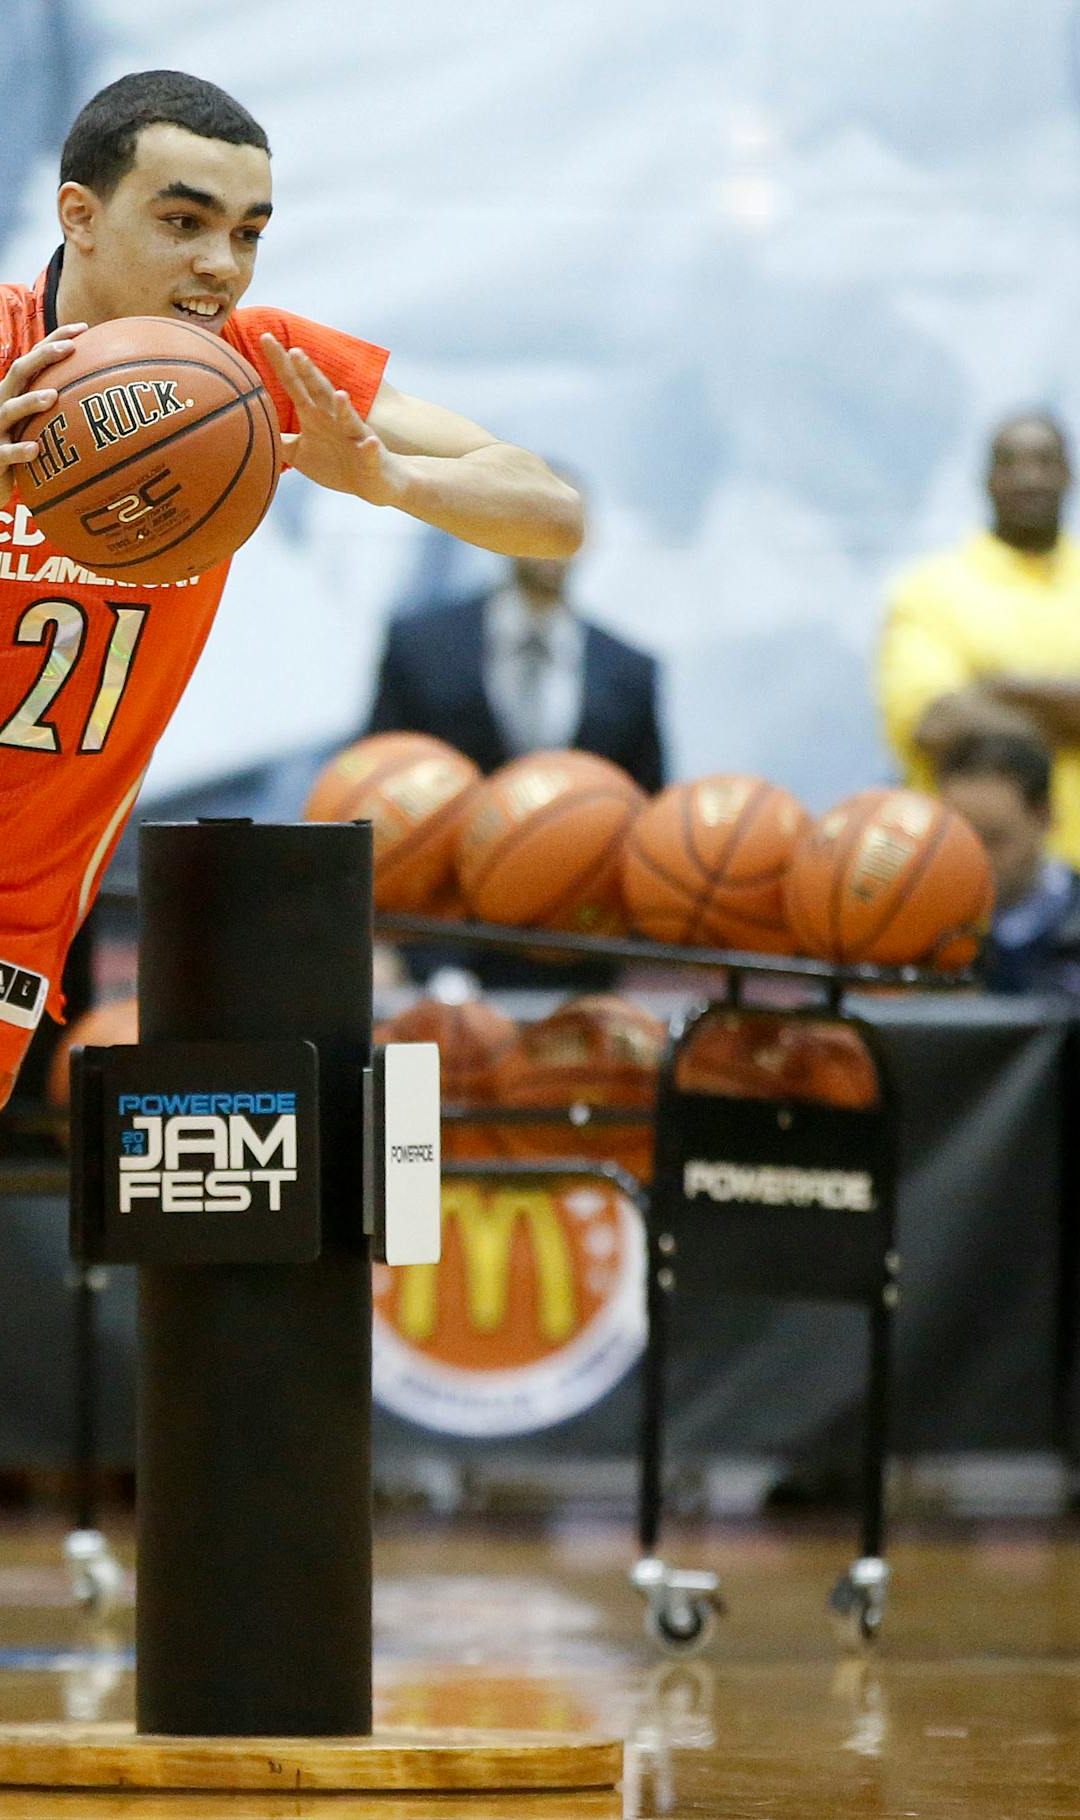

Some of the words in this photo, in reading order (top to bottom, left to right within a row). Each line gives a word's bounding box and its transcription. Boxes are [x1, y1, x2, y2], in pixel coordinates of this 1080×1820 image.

[118, 1092, 297, 1116] POWERADE
[119, 1115, 297, 1170] JAM
[119, 1170, 297, 1213] FEST
